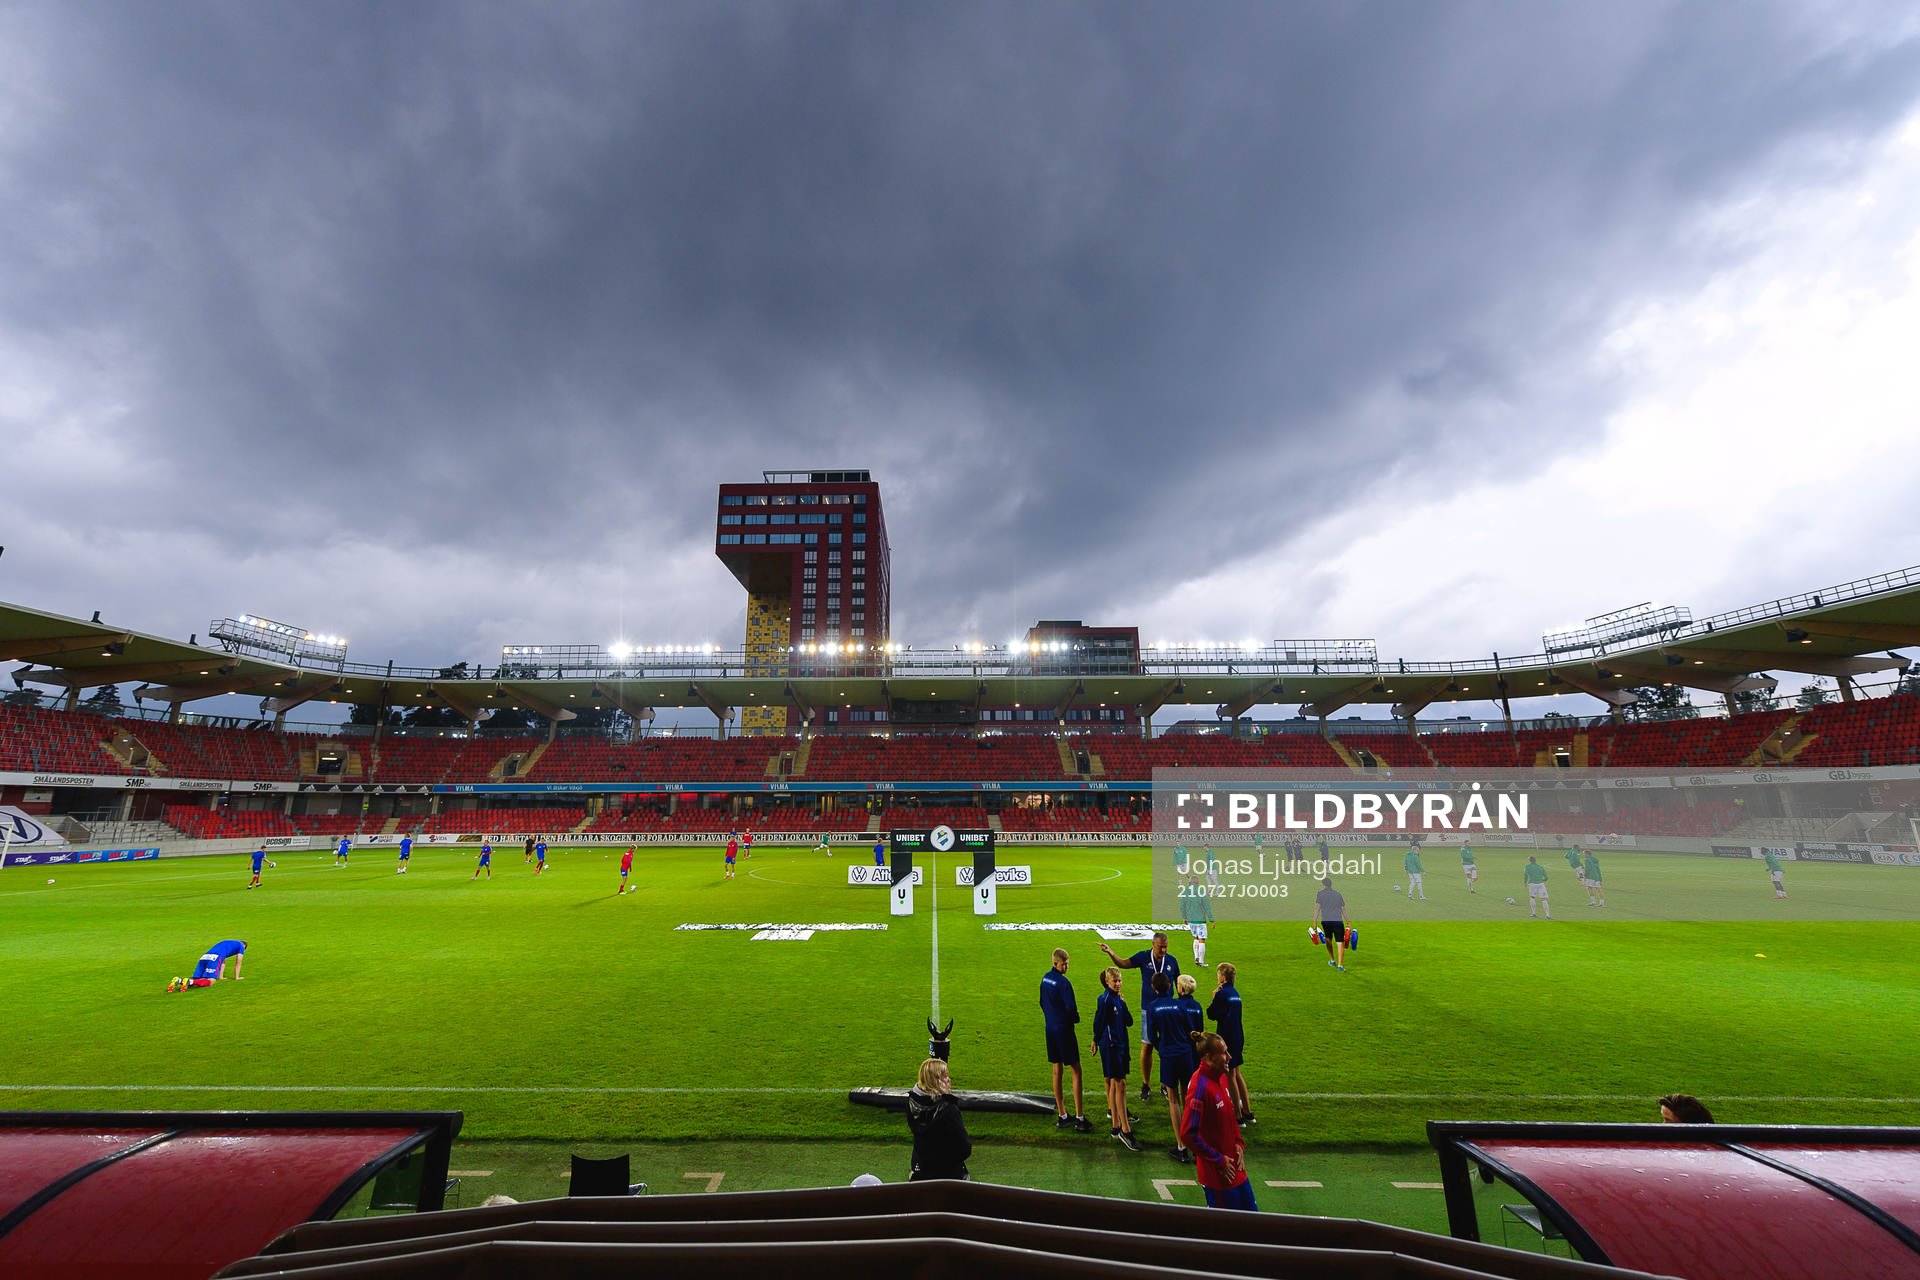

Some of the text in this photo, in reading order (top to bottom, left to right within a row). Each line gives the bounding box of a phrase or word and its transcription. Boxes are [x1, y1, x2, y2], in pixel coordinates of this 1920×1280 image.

[1753, 773, 1773, 783] GBJ
[1829, 770, 1851, 780] GBJ
[896, 834, 925, 842] UNIBET
[960, 834, 989, 842] UNIBET
[898, 888, 906, 899] U
[981, 888, 989, 899] U
